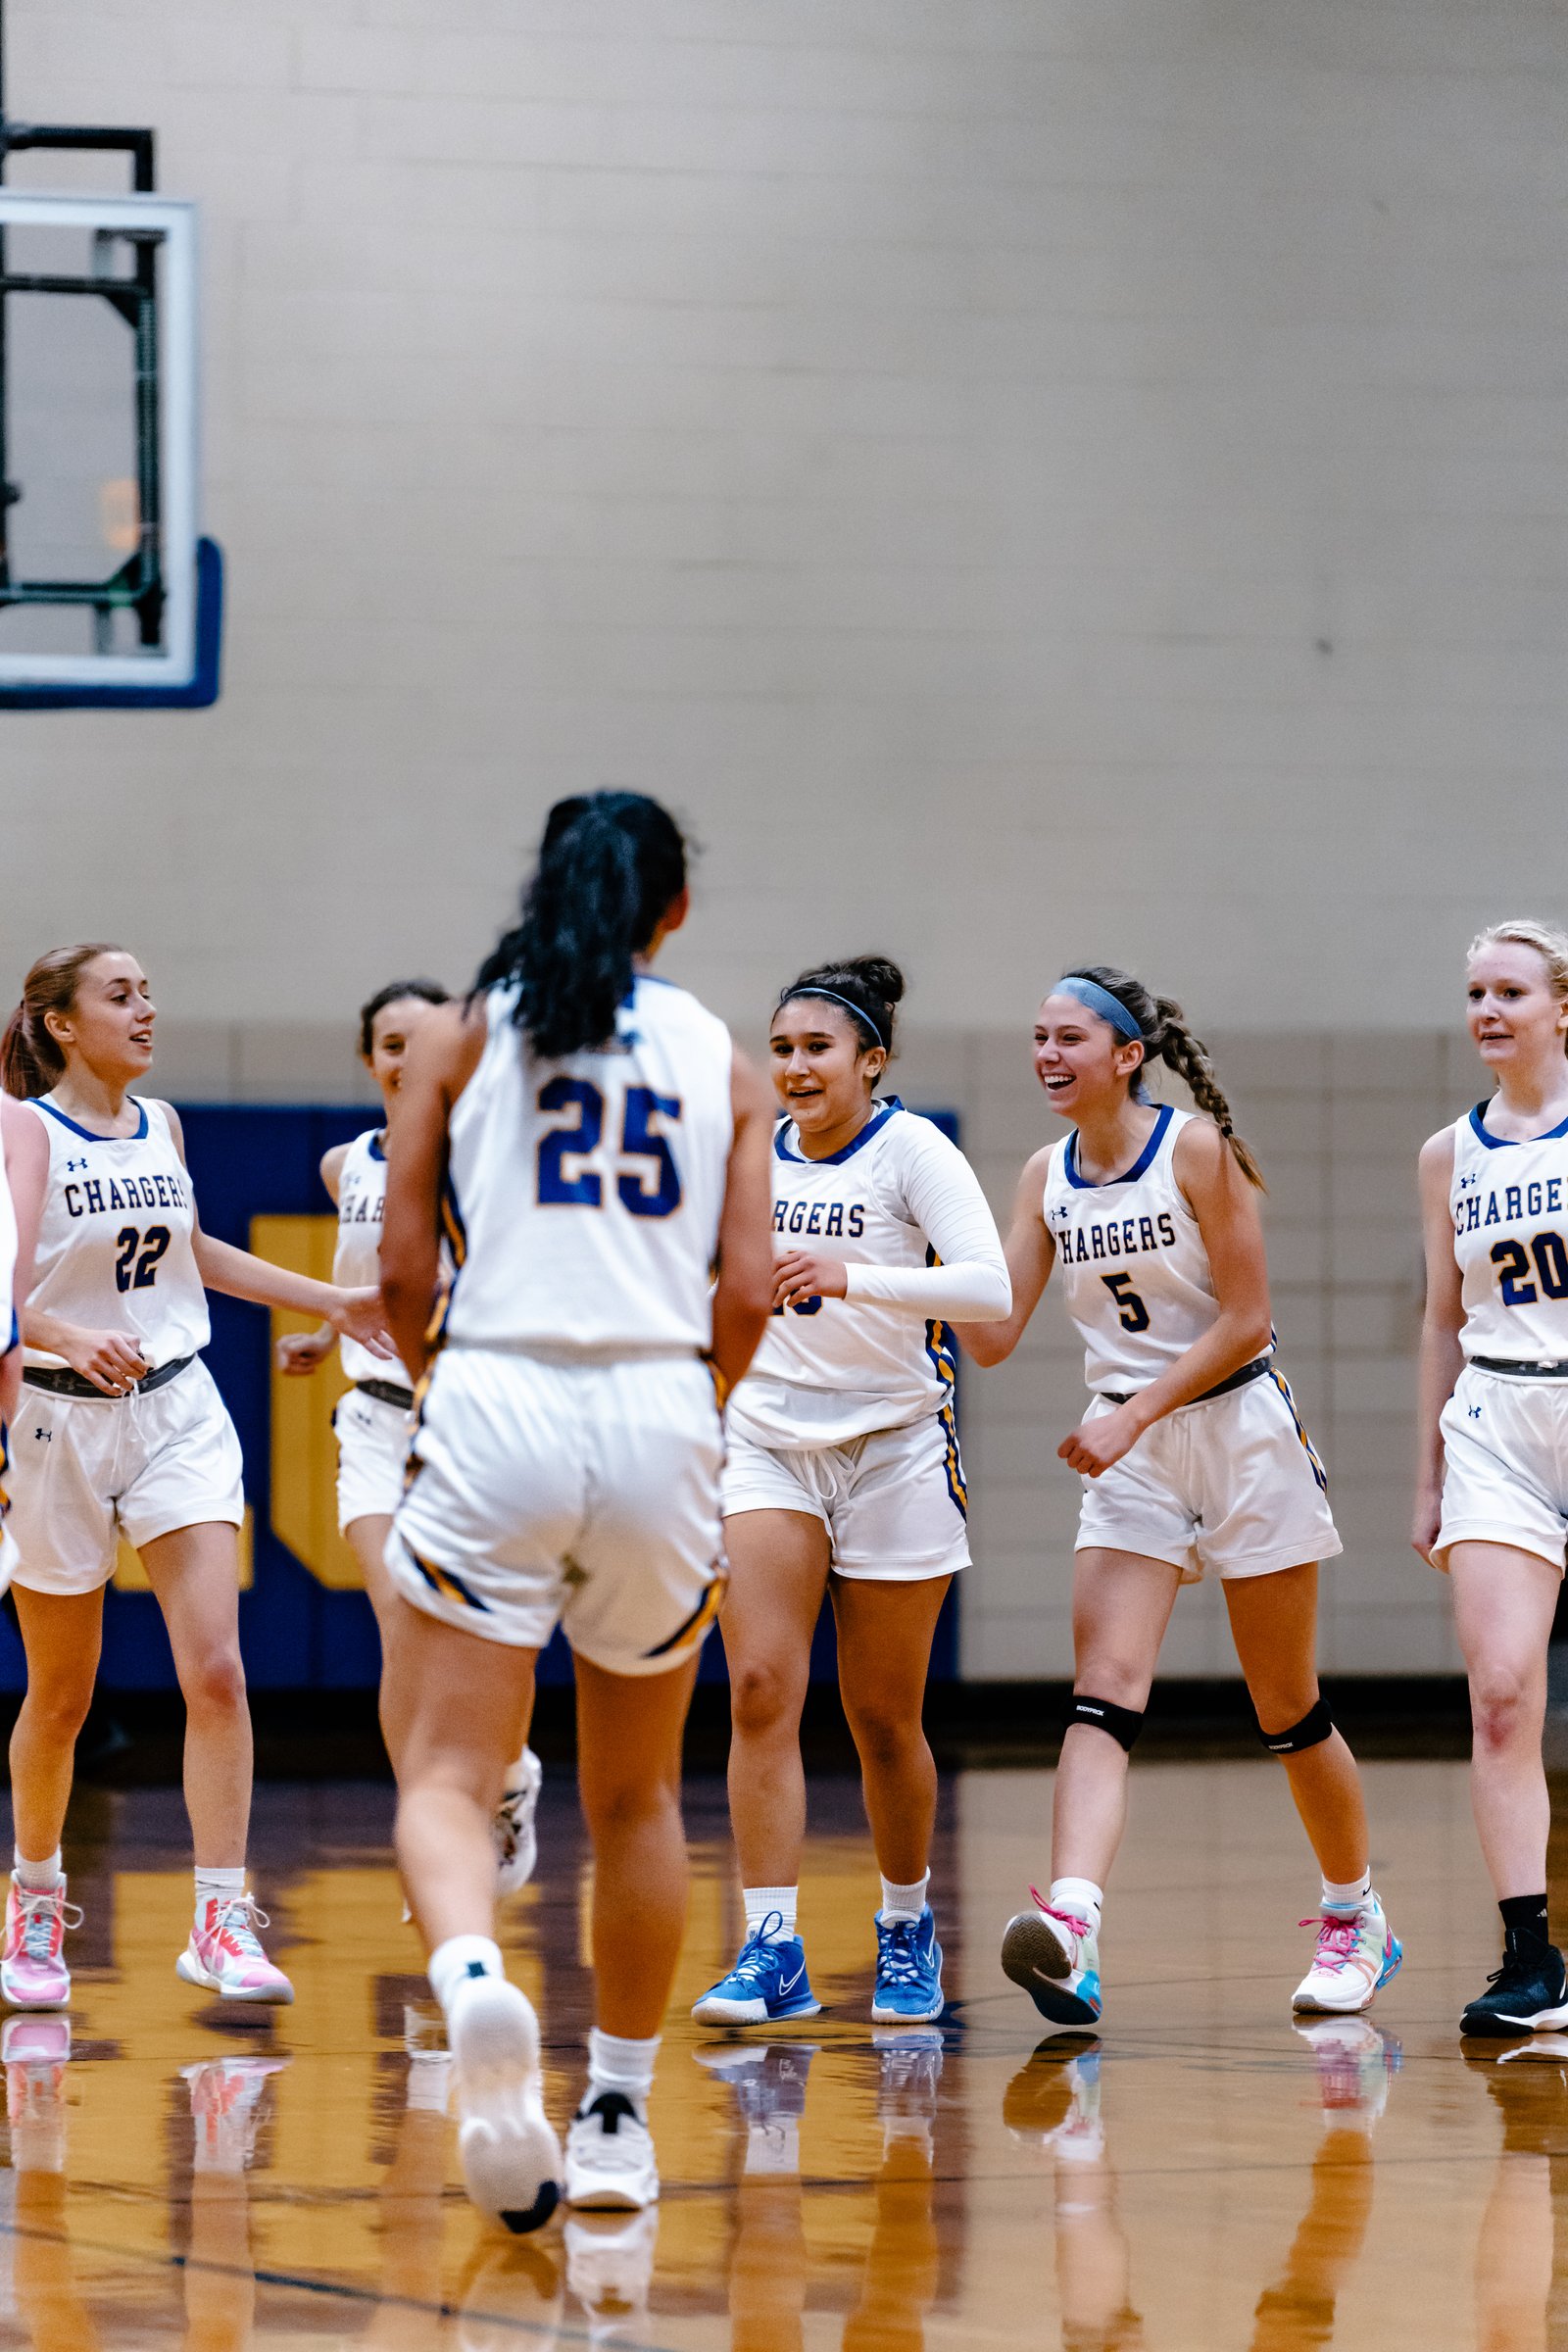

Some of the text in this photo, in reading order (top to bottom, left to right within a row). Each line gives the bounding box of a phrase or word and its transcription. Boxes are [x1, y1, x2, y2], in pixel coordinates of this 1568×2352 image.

[536, 1076, 682, 1222] 25
[1055, 1212, 1176, 1264] HARGERS
[1456, 1177, 1568, 1236] CHARGE
[116, 1224, 172, 1294] 22
[1490, 1229, 1568, 1306] 20
[1100, 1271, 1152, 1334] 5
